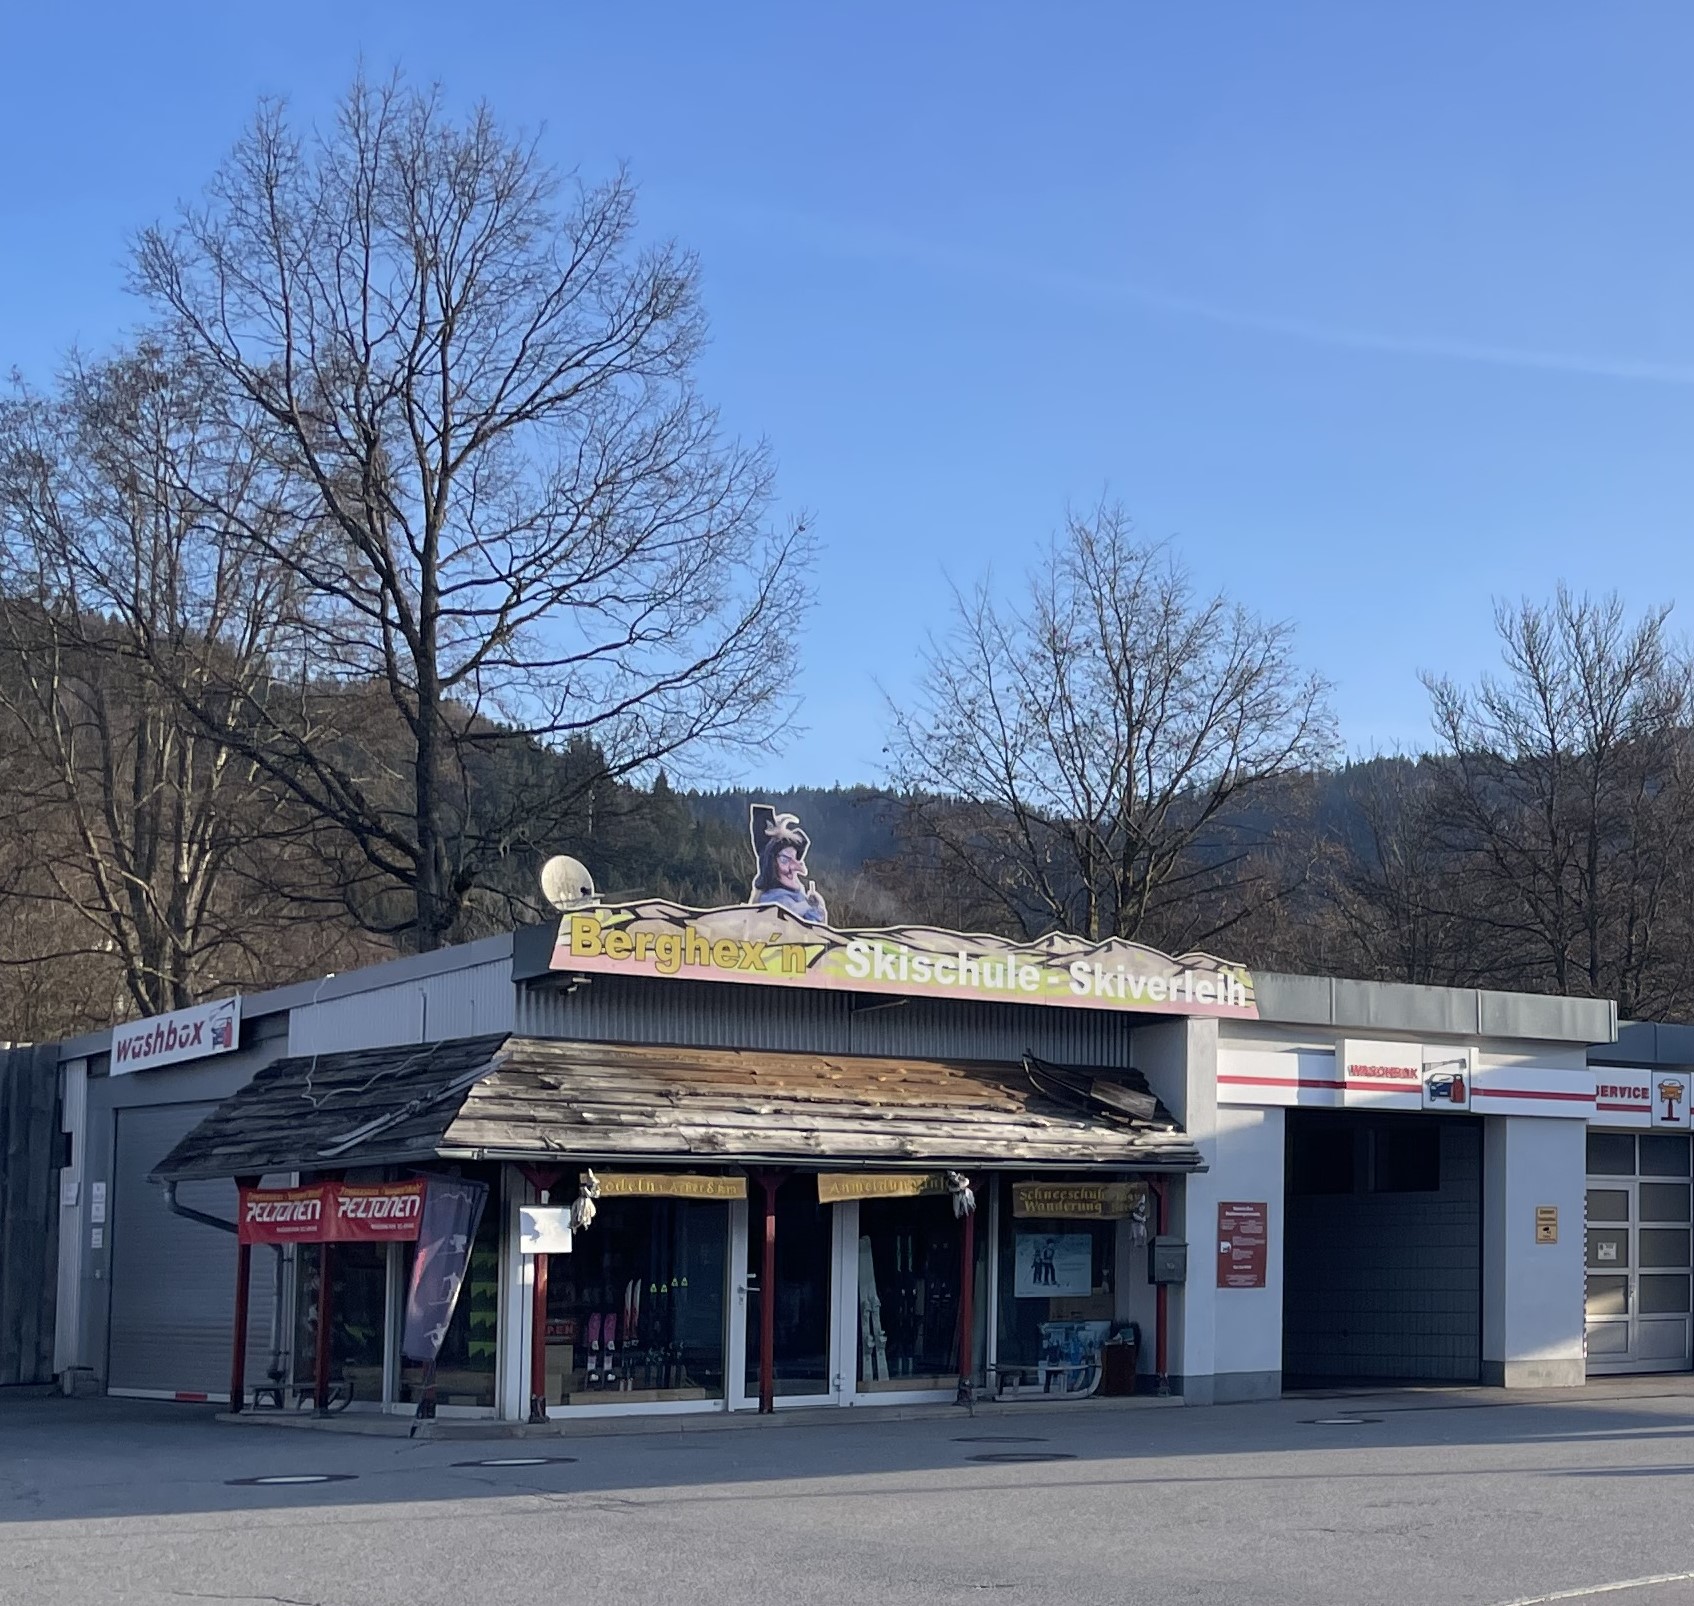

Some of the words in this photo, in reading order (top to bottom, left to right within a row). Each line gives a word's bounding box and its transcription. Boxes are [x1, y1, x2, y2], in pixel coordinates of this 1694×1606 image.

[845, 941, 1040, 990] Skischule
[1069, 961, 1247, 1007] Skiverleih
[246, 1200, 322, 1223] PELTONEN
[337, 1194, 421, 1219] PELTONEN
